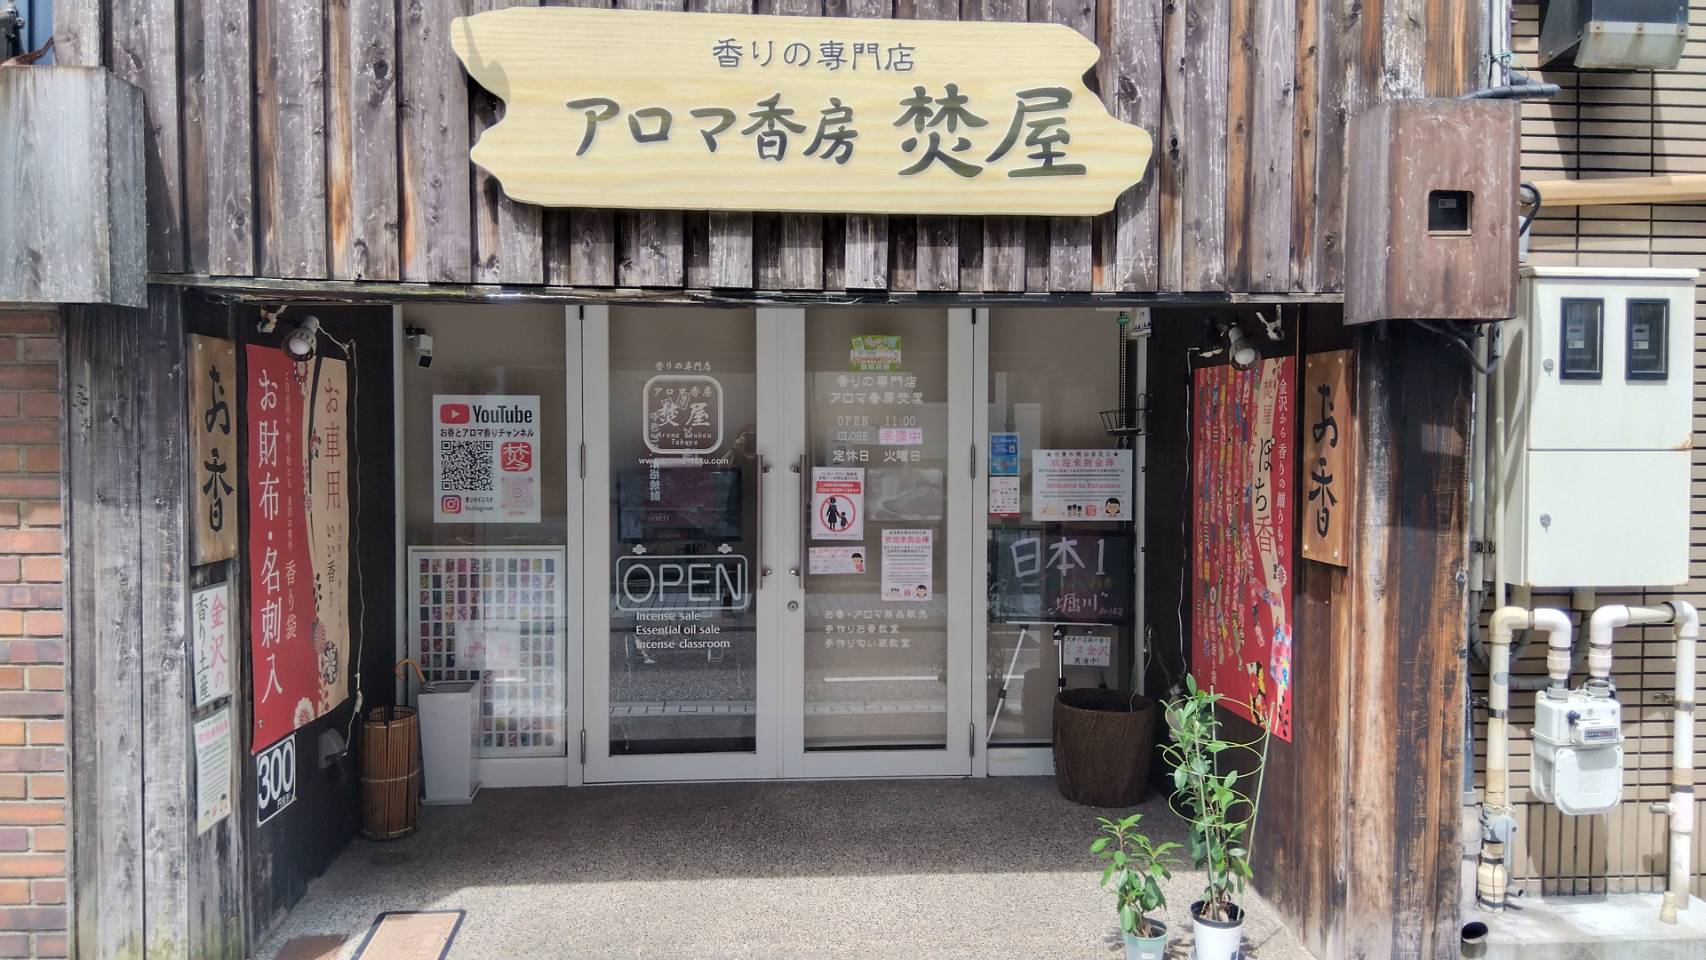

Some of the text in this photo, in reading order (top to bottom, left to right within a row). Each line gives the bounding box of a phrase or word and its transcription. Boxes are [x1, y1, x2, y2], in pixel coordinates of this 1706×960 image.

[711, 38, 916, 72] 香りの専門店
[566, 82, 1087, 178] アロマ香房 焚屋
[655, 361, 712, 372] 香りの専門店
[837, 375, 918, 389] 香りの専門店
[472, 405, 533, 424] YouTube
[837, 415, 916, 426] OPEN 11:00
[837, 431, 869, 441] CLOSE
[203, 365, 234, 532] お香
[832, 450, 921, 462] 定休日 火曜日
[1308, 383, 1338, 538] お香
[623, 563, 742, 603] OPEN
[285, 560, 297, 641] 香り袋
[636, 611, 701, 621] Incense sale
[824, 609, 928, 619] お香・アロマ商品販売
[635, 624, 721, 635] Essential oil sale
[825, 624, 900, 634] 手作りお香教室
[210, 593, 227, 689] 金沢の
[636, 639, 731, 649] Incense classroom
[258, 740, 294, 810] 300
